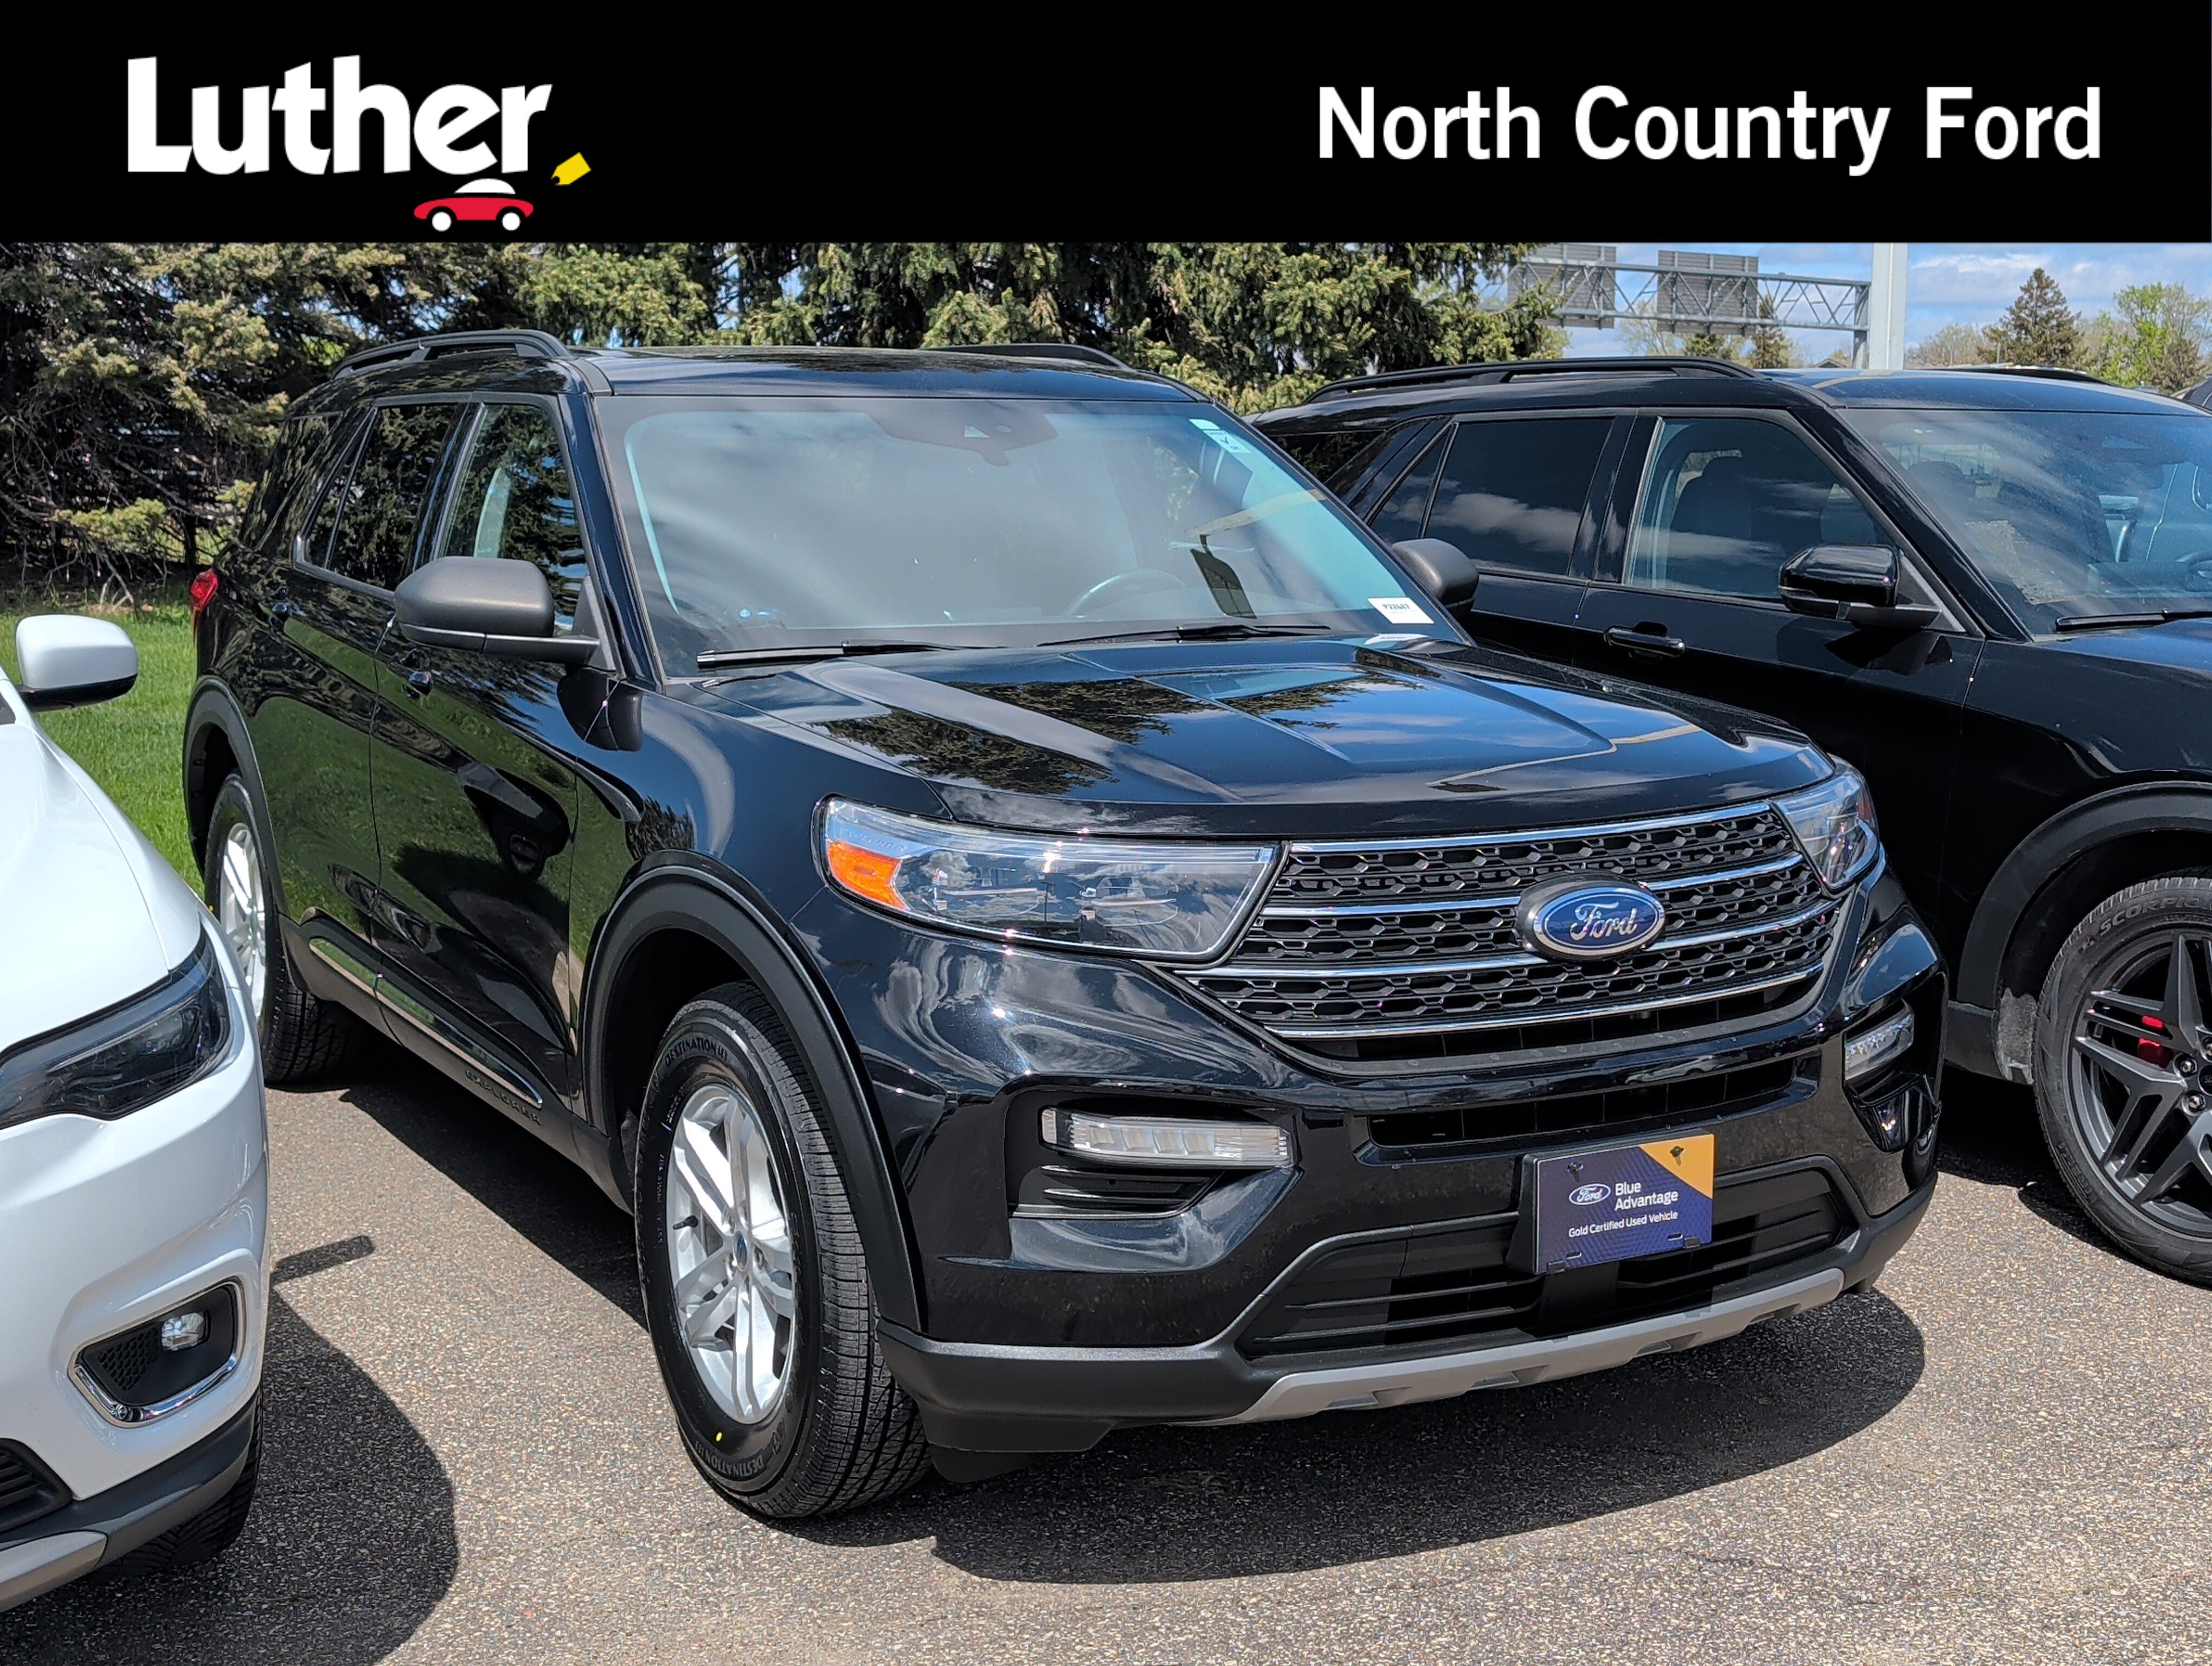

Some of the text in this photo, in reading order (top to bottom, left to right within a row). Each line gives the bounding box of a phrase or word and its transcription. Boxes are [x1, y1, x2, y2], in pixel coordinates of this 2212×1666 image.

[1570, 901, 1638, 941] Ford
[665, 1037, 717, 1065] DESTINATION
[1577, 1187, 1603, 1202] Ford
[1615, 1181, 1642, 1196] Blue
[1615, 1191, 1679, 1211] Advantage
[1568, 1210, 1679, 1238] Gold Certified Used Vehicle
